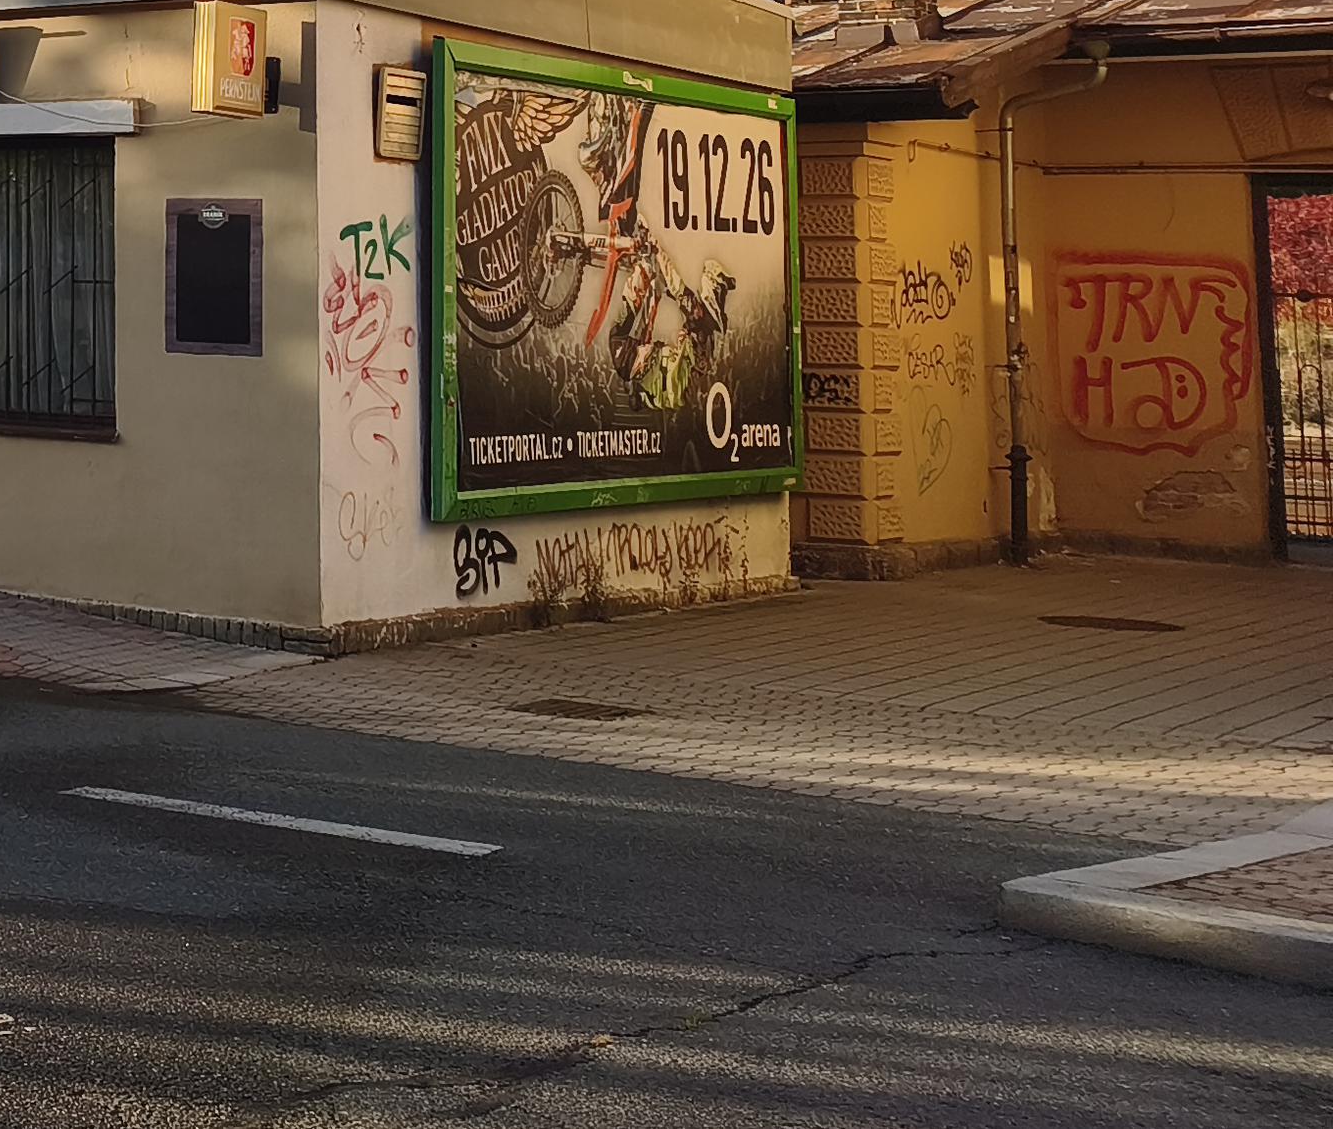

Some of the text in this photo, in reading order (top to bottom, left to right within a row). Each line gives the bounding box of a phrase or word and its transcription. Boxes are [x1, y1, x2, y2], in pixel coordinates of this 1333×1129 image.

[462, 111, 512, 193] FMX
[657, 128, 775, 236] 19.12.26
[741, 423, 781, 448] arena
